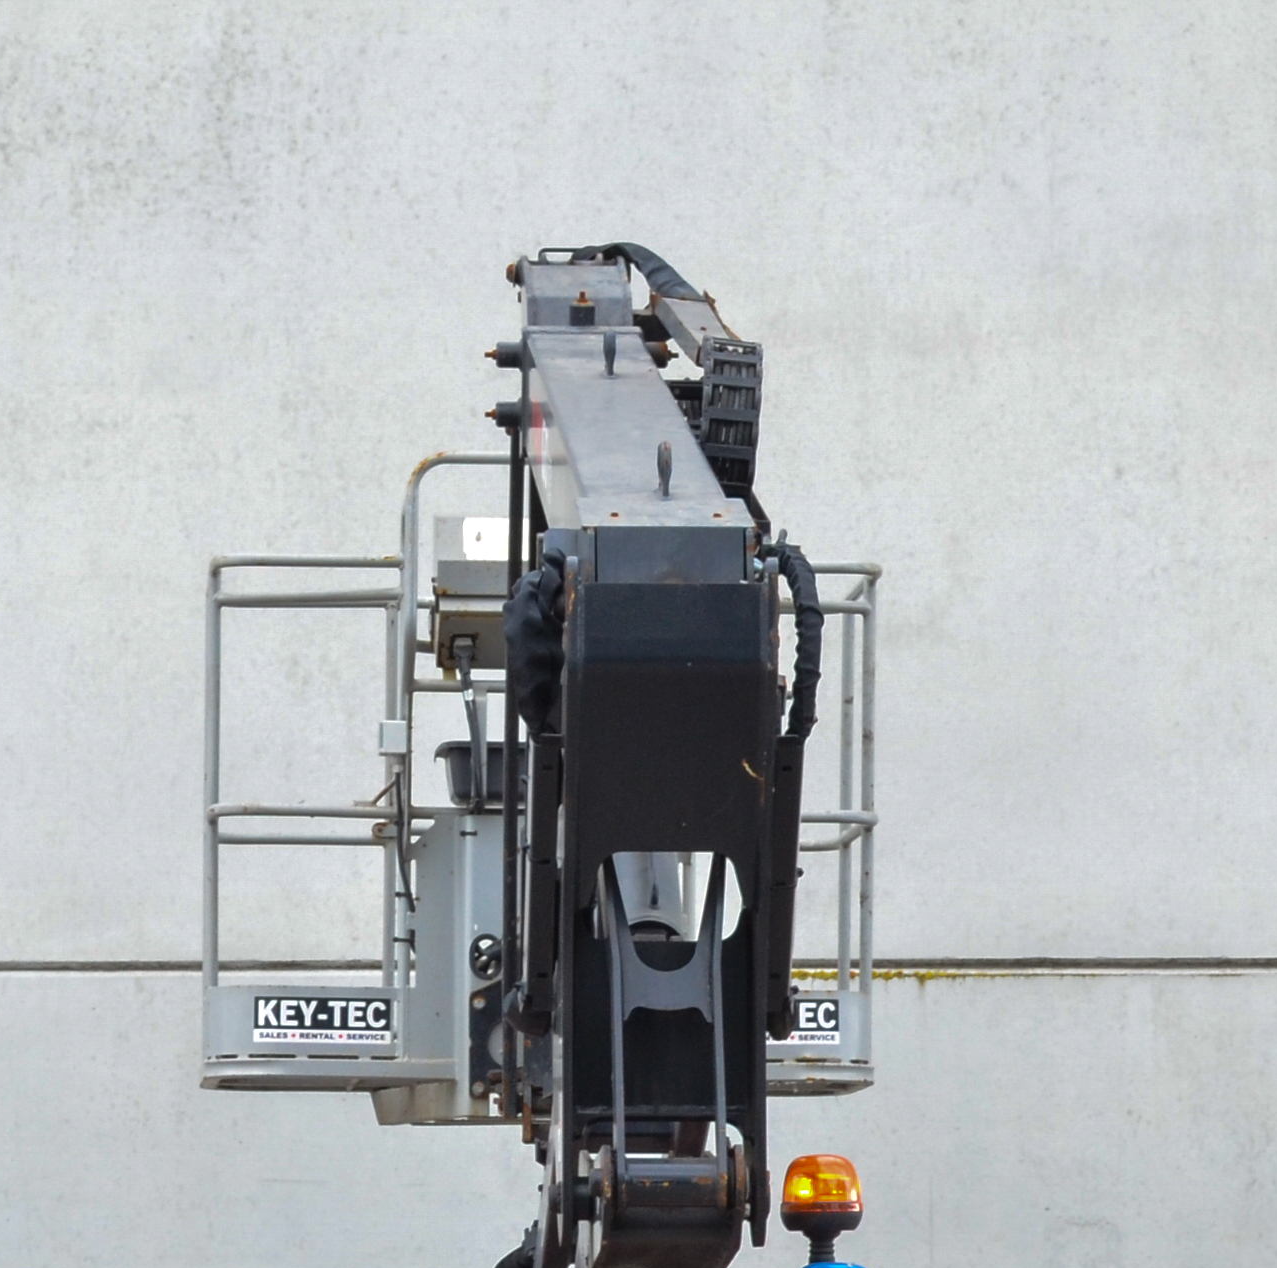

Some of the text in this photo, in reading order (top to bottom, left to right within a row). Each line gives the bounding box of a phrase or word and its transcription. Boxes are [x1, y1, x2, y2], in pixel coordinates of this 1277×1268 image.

[258, 999, 387, 1028] KEY-TEC
[299, 1032, 335, 1040] RENTAL
[346, 1033, 386, 1041] SERVICE
